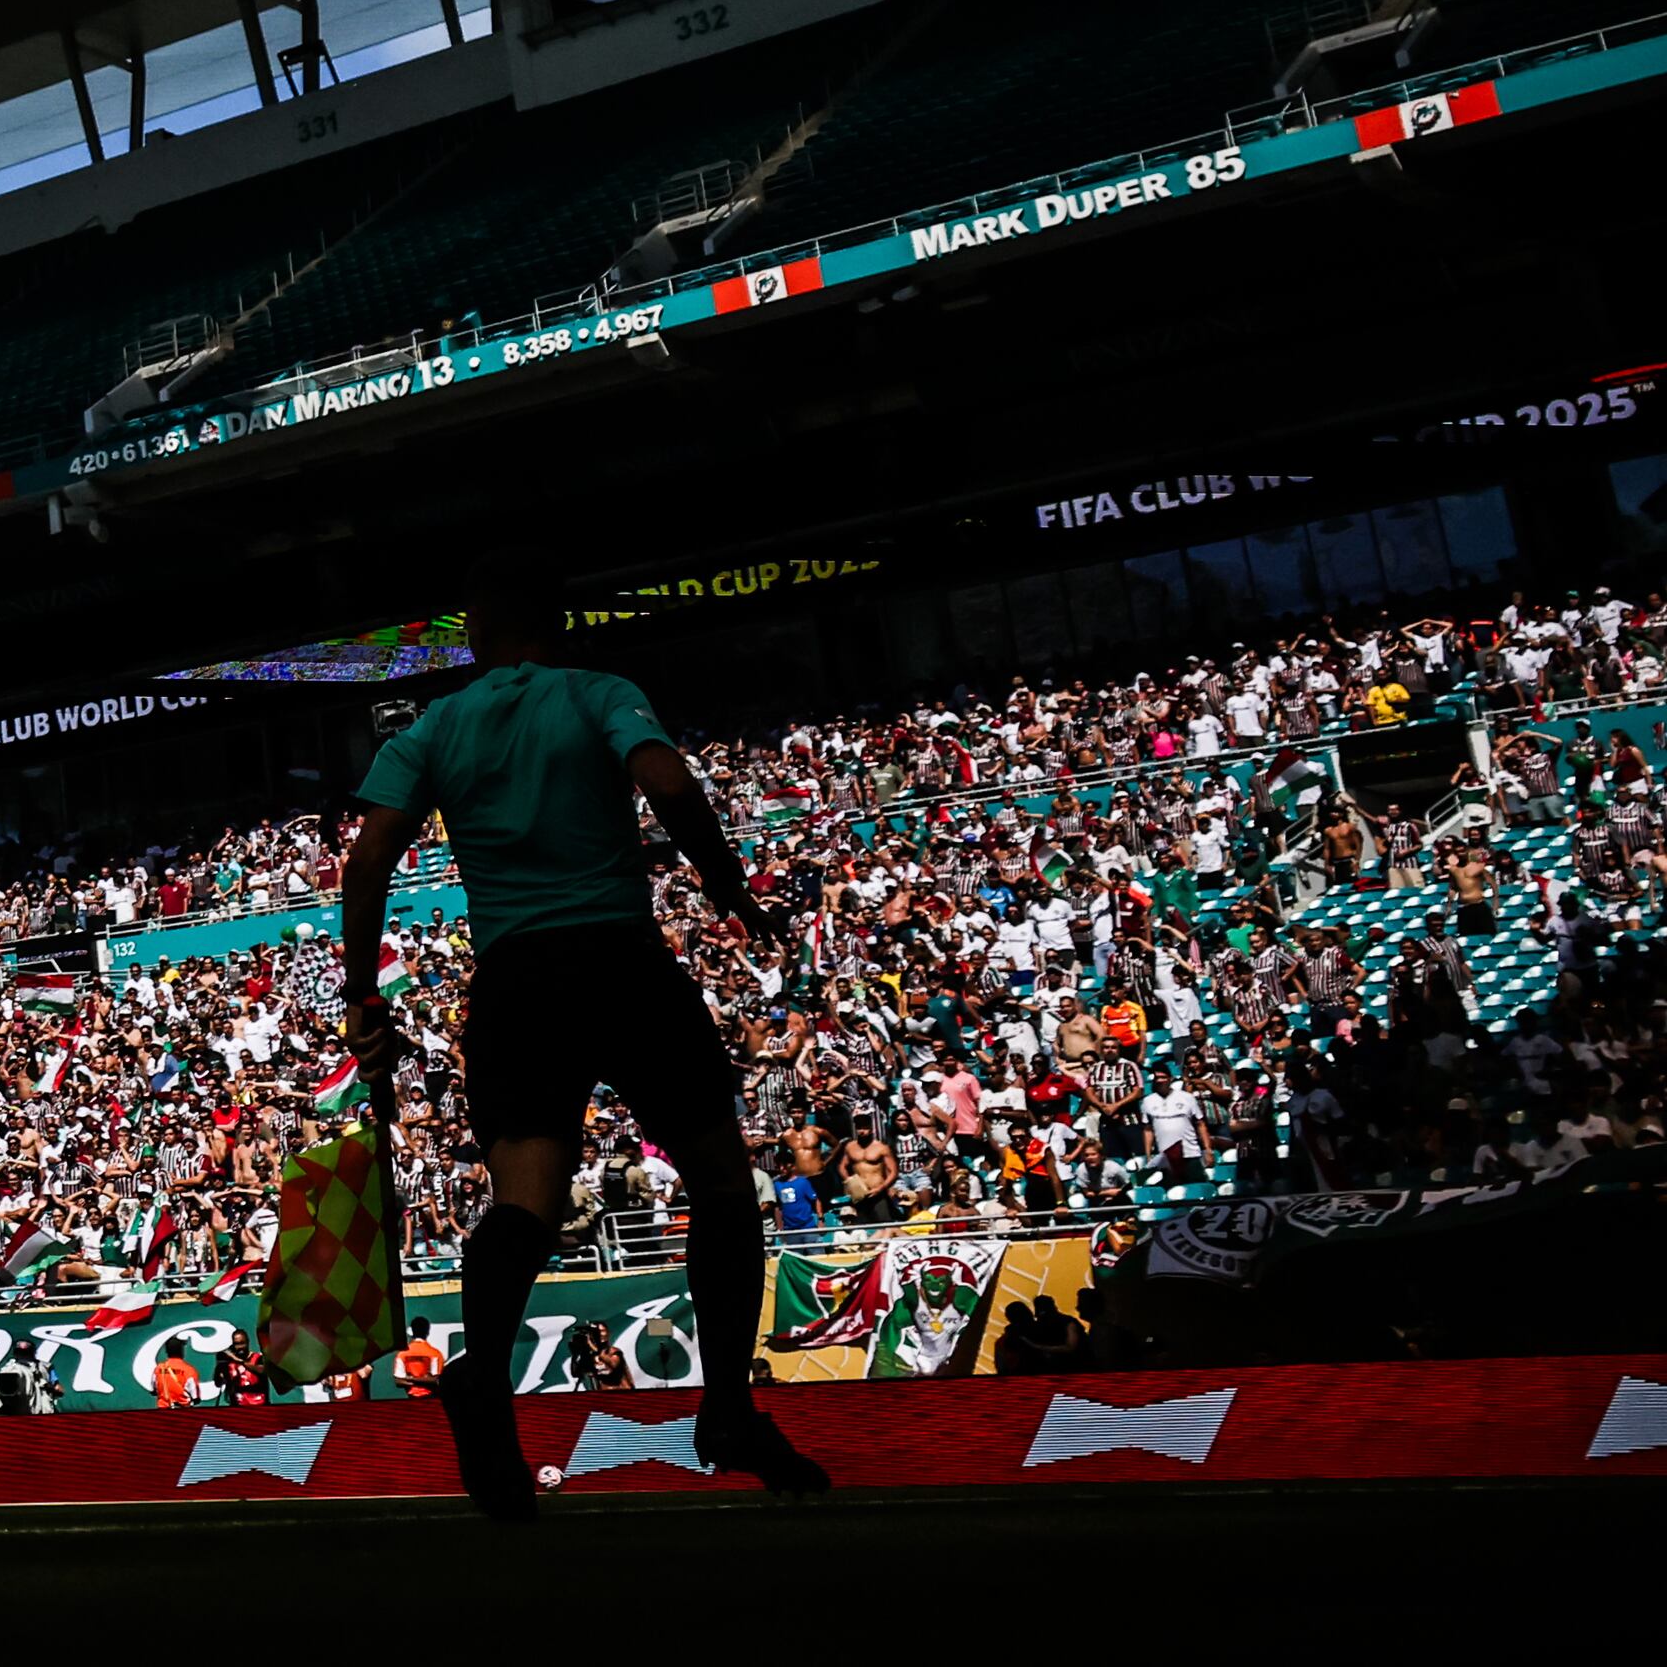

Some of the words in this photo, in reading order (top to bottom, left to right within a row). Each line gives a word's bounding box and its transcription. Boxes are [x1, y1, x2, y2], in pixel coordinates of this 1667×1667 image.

[675, 4, 729, 40] 332
[298, 112, 337, 143] 331
[909, 209, 1029, 261] MARK
[1035, 172, 1172, 229] DUPER
[1184, 146, 1246, 189] 85
[226, 406, 287, 439] DAN
[292, 373, 411, 423] MARINO
[418, 355, 456, 389] 13
[503, 329, 571, 366] 8,358
[594, 305, 665, 341] 4,967
[1035, 495, 1123, 529] FIFA
[1130, 475, 1235, 516] CLUB
[711, 562, 780, 597] CUP
[55, 696, 156, 734] WORLD
[113, 941, 137, 957] 132
